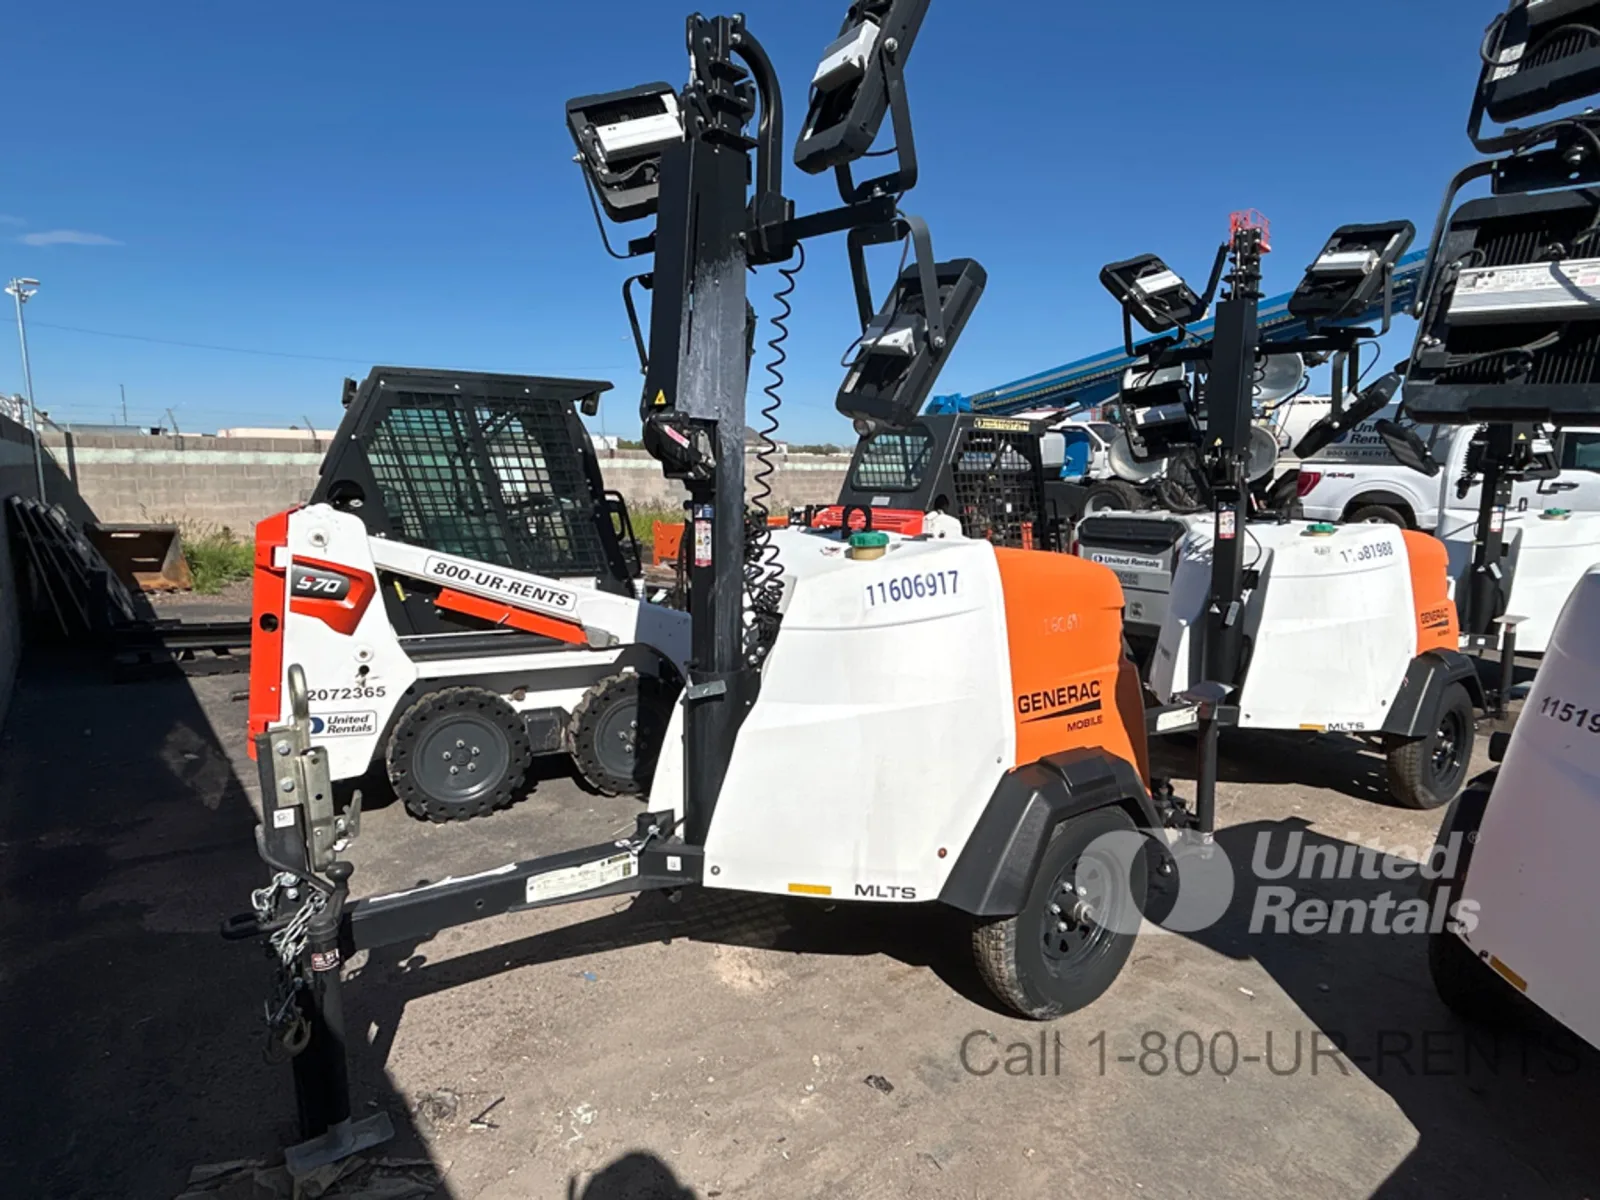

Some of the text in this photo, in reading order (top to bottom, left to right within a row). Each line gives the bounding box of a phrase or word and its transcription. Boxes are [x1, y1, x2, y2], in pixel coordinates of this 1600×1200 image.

[1104, 556, 1160, 568] United Rentals
[433, 562, 570, 606] 800-UR-RENTS
[866, 570, 958, 607] 11606917
[1018, 680, 1101, 714] GENERAC
[327, 714, 369, 725] United
[1067, 715, 1103, 732] MOBILE
[1328, 722, 1365, 731] MLTS
[326, 725, 372, 734] Rentals
[855, 884, 917, 899] MLTS
